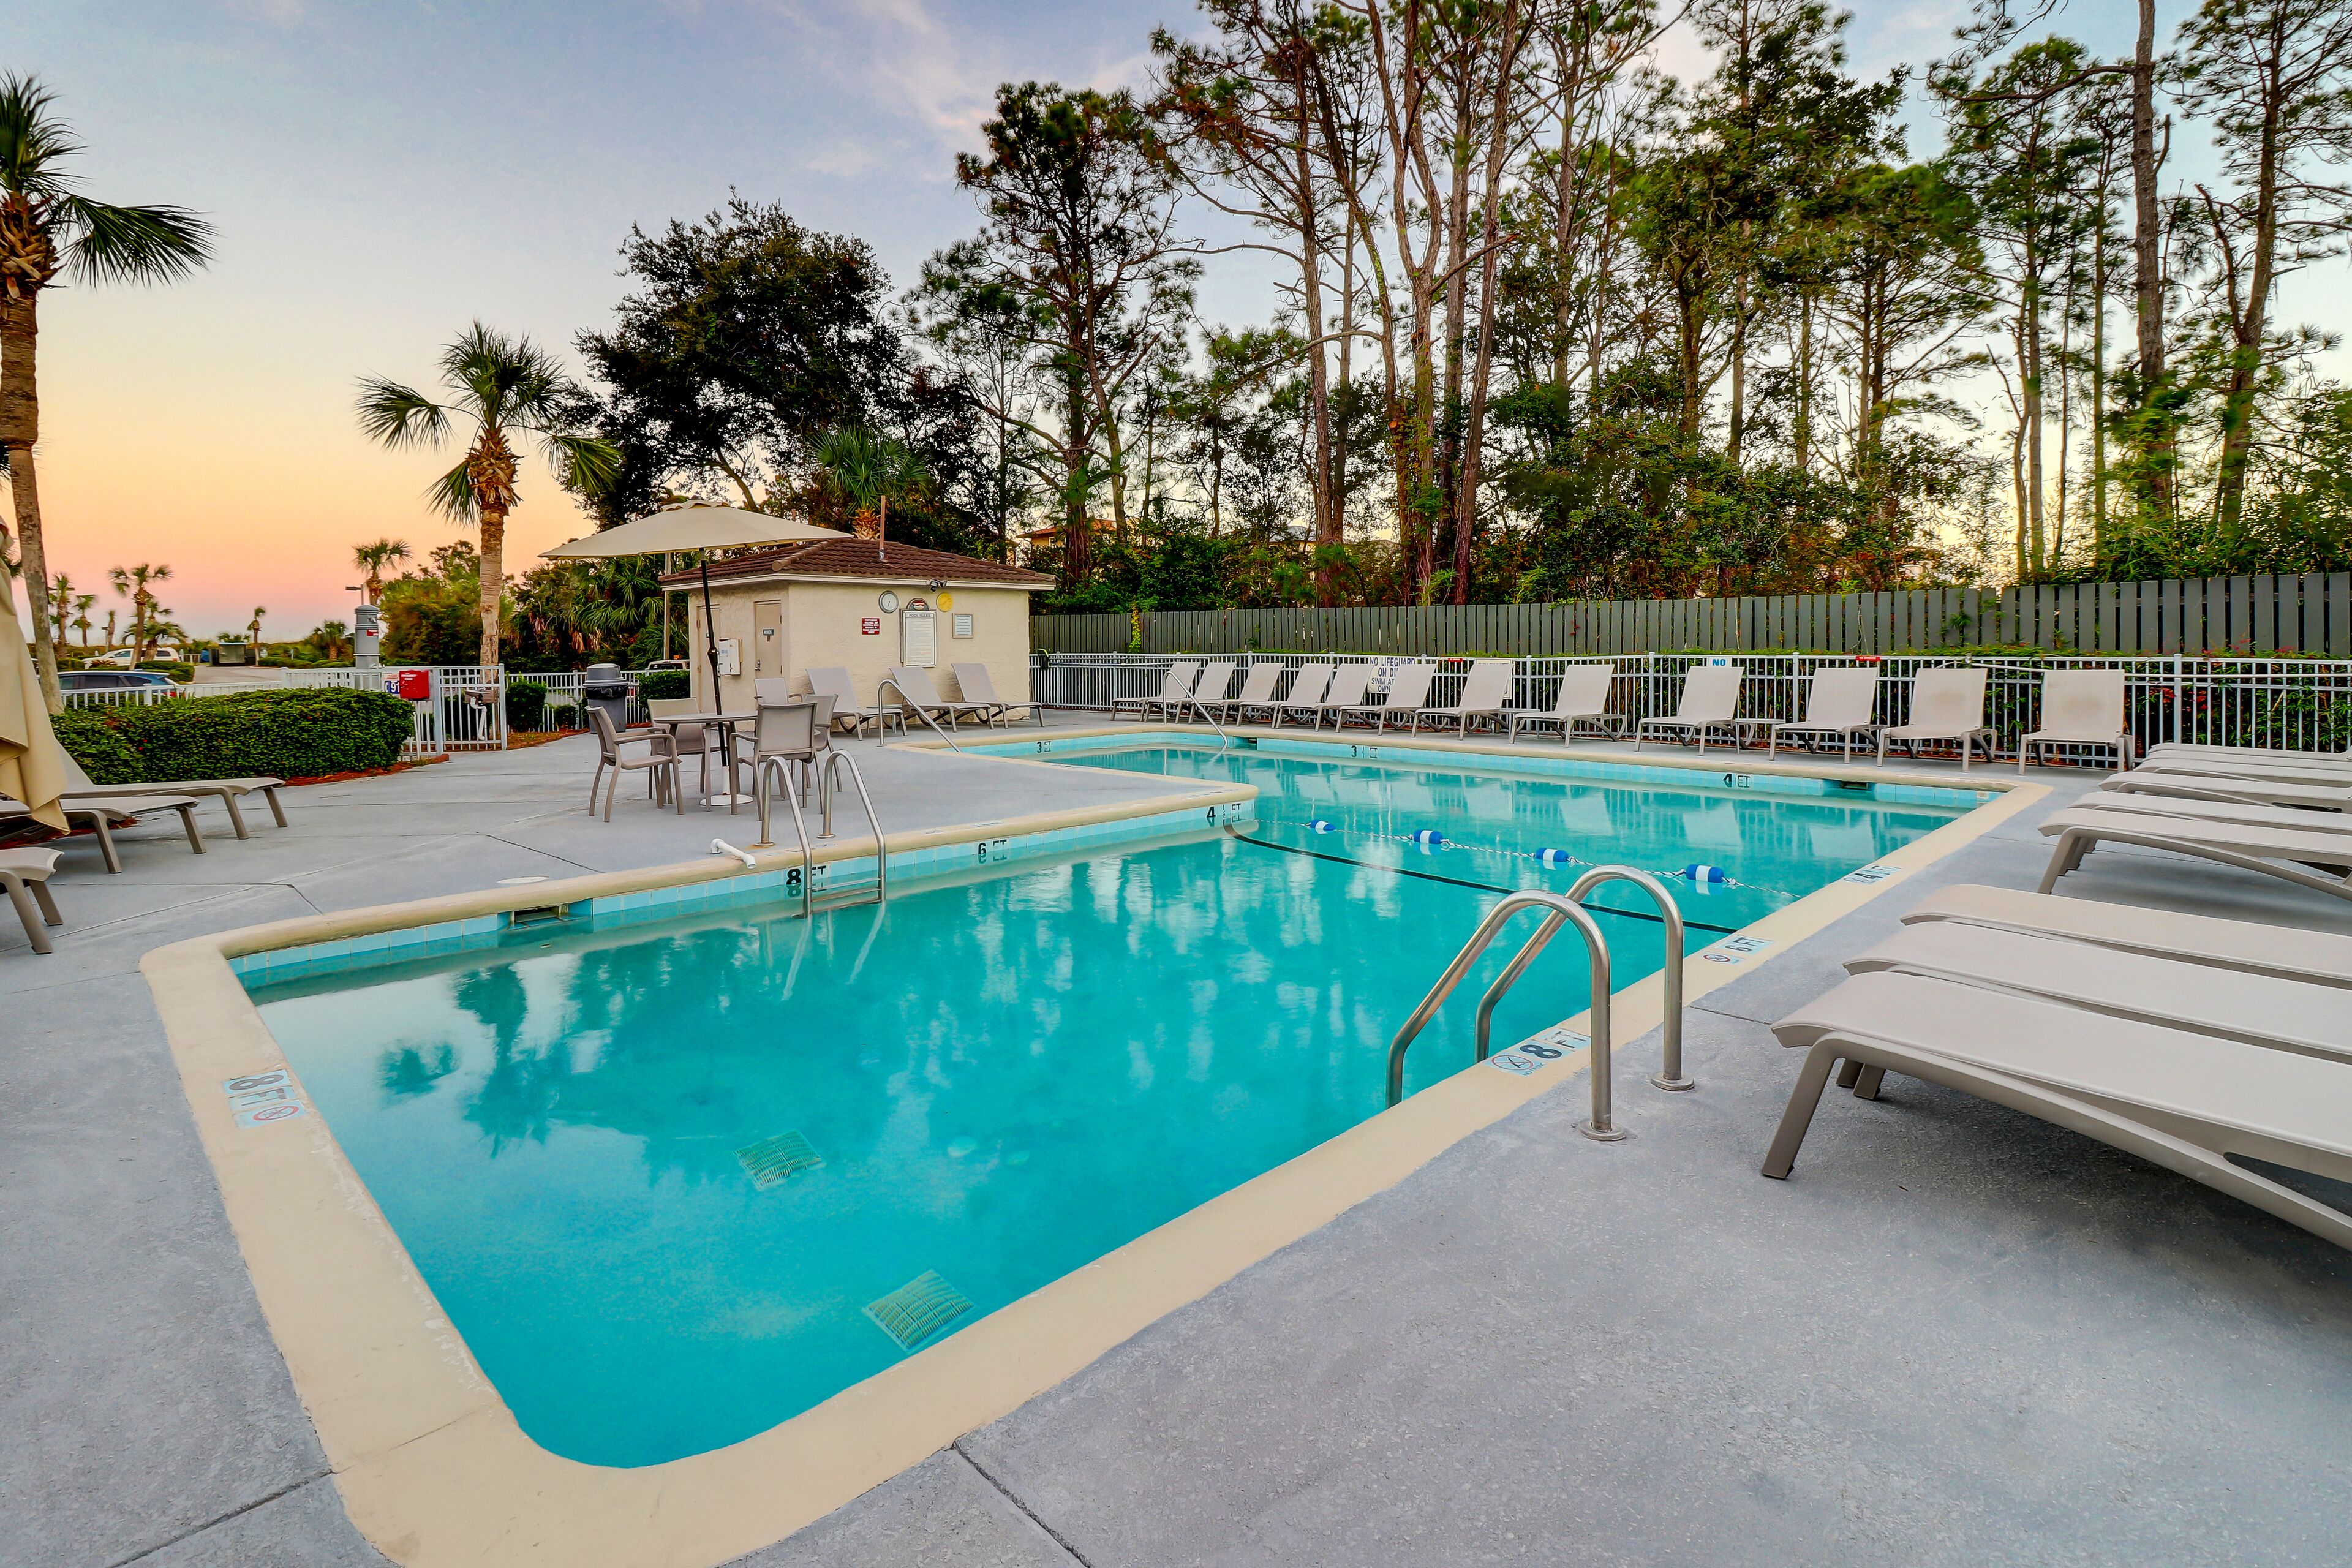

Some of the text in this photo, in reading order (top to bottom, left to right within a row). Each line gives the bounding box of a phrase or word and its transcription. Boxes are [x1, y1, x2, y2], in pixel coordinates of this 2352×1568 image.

[1370, 657, 1378, 666] NO
[1378, 667, 1387, 677] ON
[391, 682, 400, 692] 91
[1207, 806, 1216, 818] 4
[786, 868, 801, 884] 8
[1733, 937, 1765, 946] FT
[1520, 1031, 1587, 1059] 8 FT
[228, 1074, 287, 1106] 8 FT
